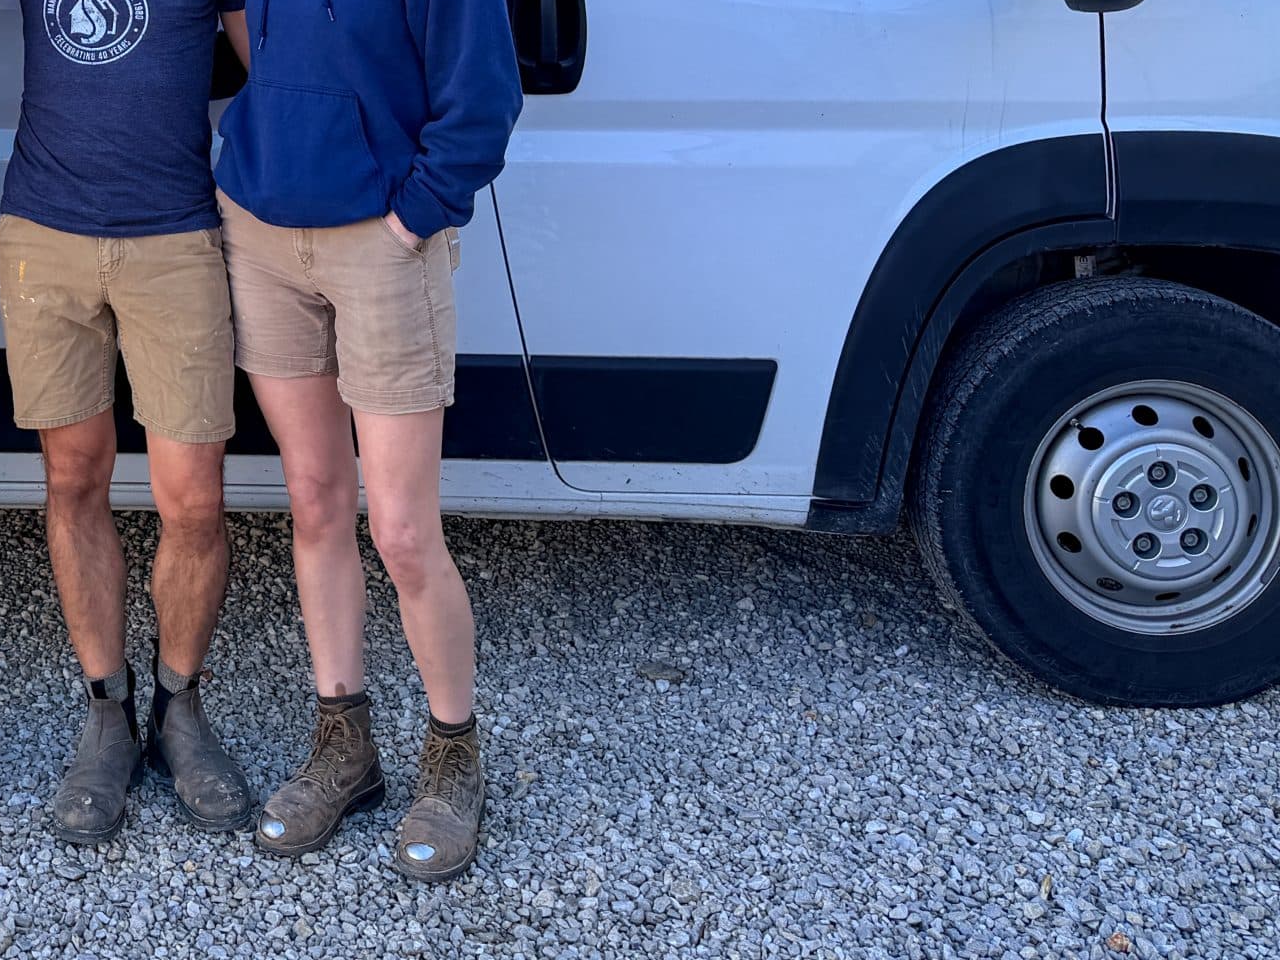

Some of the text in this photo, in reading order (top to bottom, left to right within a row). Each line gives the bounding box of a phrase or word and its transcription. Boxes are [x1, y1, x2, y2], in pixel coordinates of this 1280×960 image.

[133, 2, 144, 20] 1980
[54, 34, 132, 61] CELEBRATING 40 YEARS
